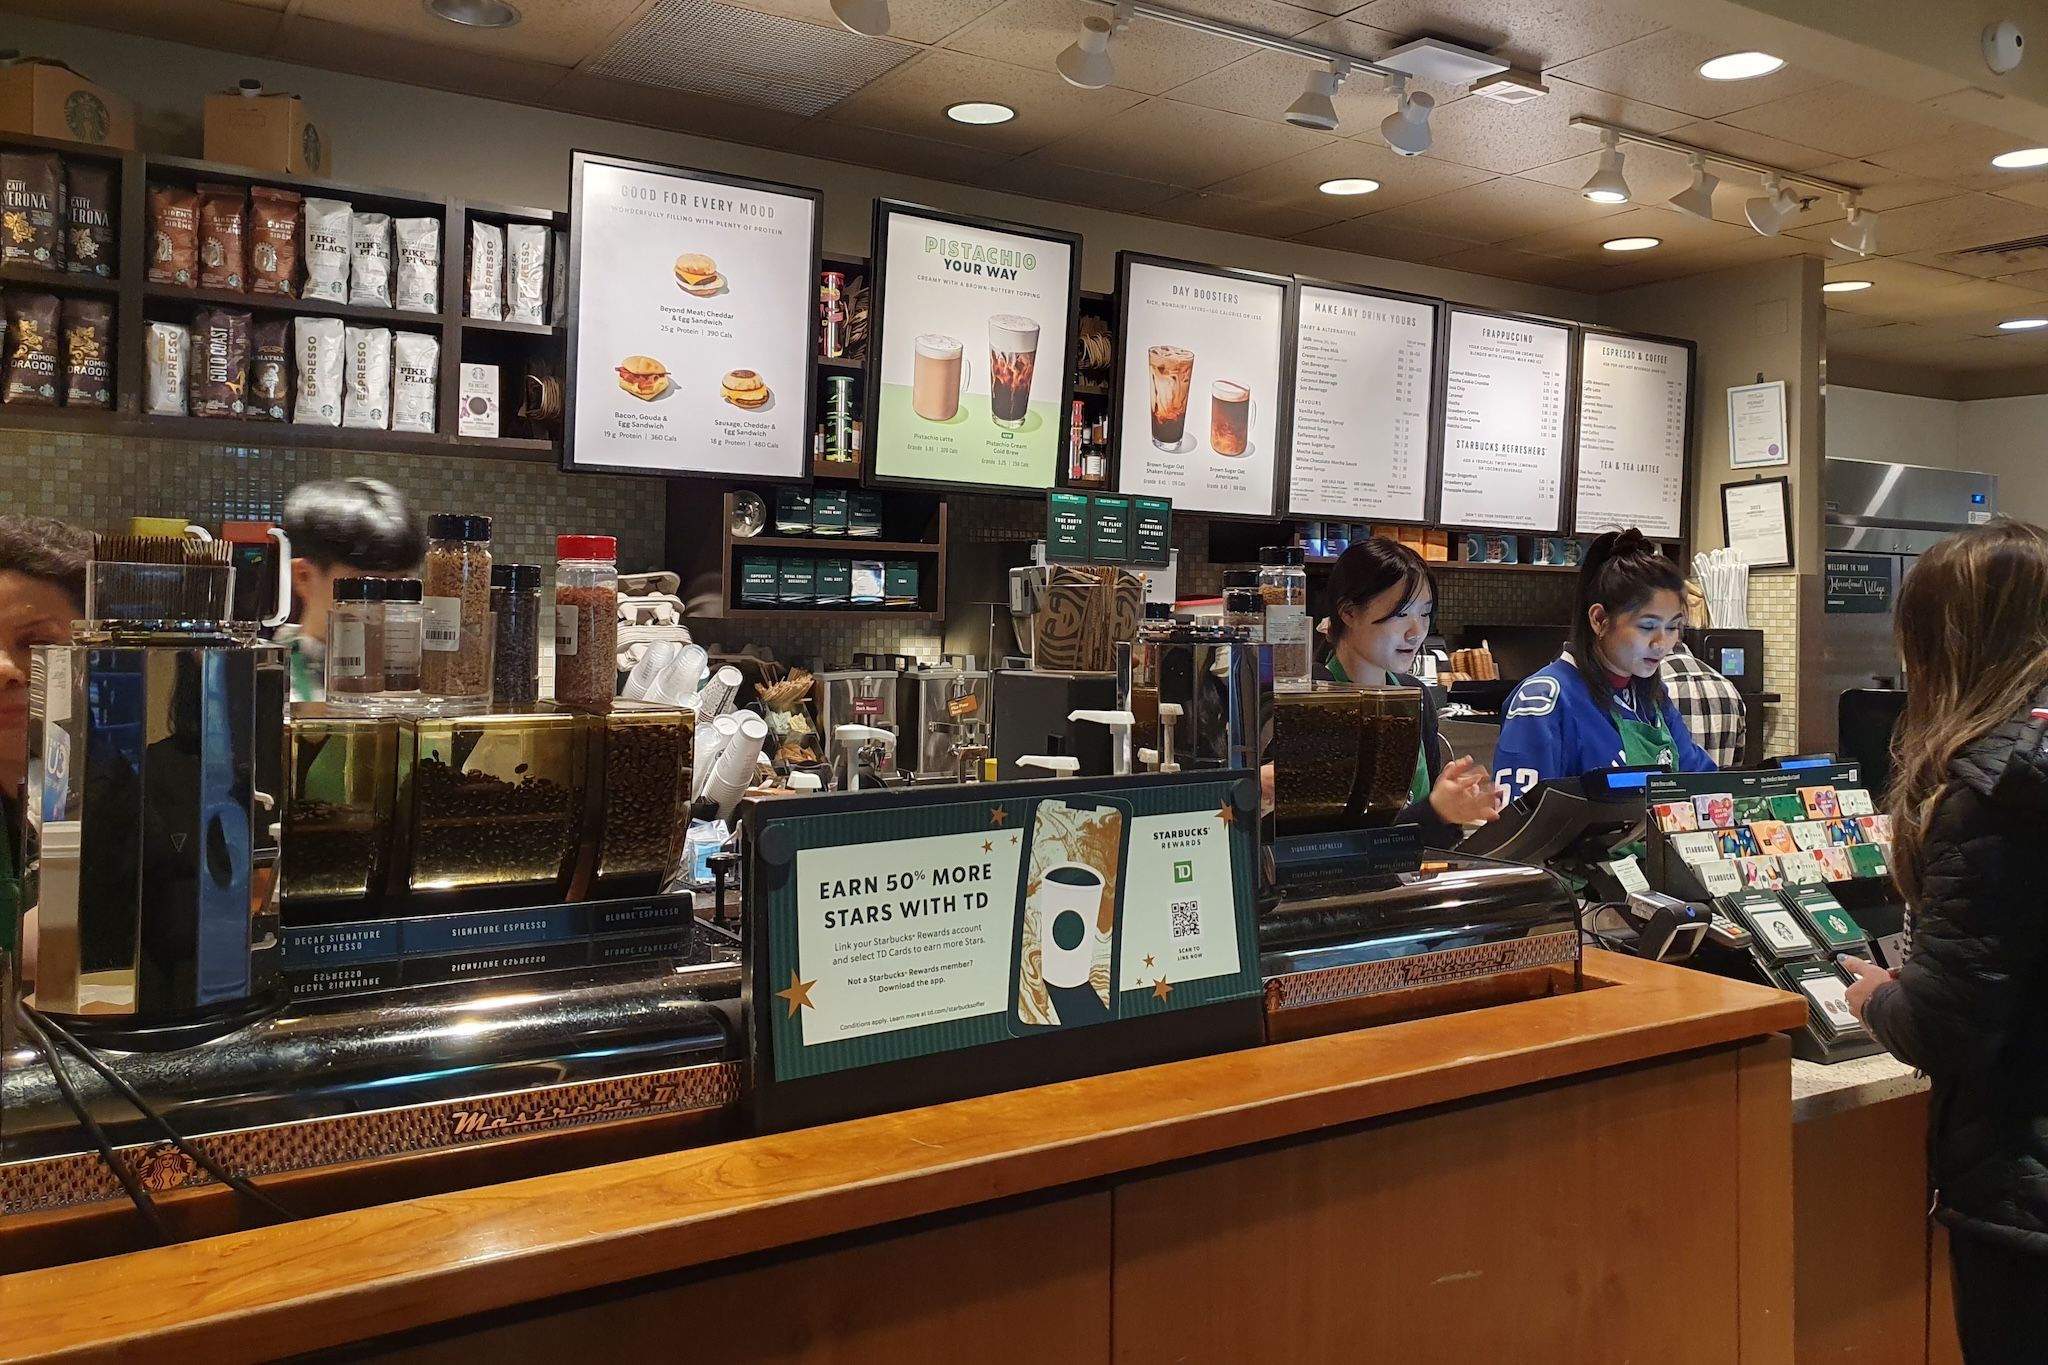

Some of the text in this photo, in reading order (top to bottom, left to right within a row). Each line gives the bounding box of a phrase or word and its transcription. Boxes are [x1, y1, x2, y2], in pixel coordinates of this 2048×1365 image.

[621, 185, 775, 219] GOOD FOR EVERY MOOD
[666, 213, 693, 223] FILLING
[696, 218, 714, 226] WITH
[716, 220, 741, 230] PLENTY
[754, 226, 783, 236] PROTEIN
[314, 243, 346, 254] PLACE
[401, 248, 426, 259] PIKE
[925, 236, 1037, 271] PISTACHIO
[485, 241, 494, 298] ESPRESSO
[944, 258, 1018, 281] YOUR WAY
[917, 275, 941, 284] CREAMY
[943, 278, 958, 286] WITH
[1016, 290, 1040, 299] TOPPING
[1172, 285, 1239, 304] DAY BOOSTERS
[659, 305, 734, 320] Beyond Cheddar
[1314, 303, 1416, 327] MAKE ANY DRINK YOURS
[678, 316, 690, 325] Egg
[691, 317, 723, 327] Sandwich
[677, 327, 699, 336] Protein
[1482, 328, 1533, 343] FRAPPUCCINO
[210, 327, 228, 356] COAST
[307, 336, 317, 397] ESPRESSO
[357, 342, 367, 400] ESPRESSO
[400, 367, 427, 376] PIKE
[614, 412, 637, 421] Bacon,
[639, 413, 661, 422] Gouda
[618, 420, 665, 430] Egg Sandwich
[714, 419, 742, 428] Sausage,
[743, 422, 770, 430] Cheddar
[619, 432, 643, 440] Protein
[724, 428, 767, 438] Egg Sandwich
[940, 435, 954, 443] Latte
[1456, 439, 1499, 452] STARBUCKS
[1161, 839, 1202, 849] REWARDS
[1685, 845, 1714, 854] STARBUCKS
[1175, 863, 1191, 879] TD
[1708, 873, 1736, 883] STARBUCKS
[819, 863, 992, 900] EARN 50% MORE
[639, 907, 679, 918] ESPRESSO
[824, 891, 989, 929] STARS WITH TD
[451, 920, 547, 937] SIGNATURE ESPRESSO
[295, 930, 381, 946] DECAF SIGNATURE
[834, 939, 852, 952] Link
[853, 941, 872, 950] your
[917, 928, 950, 939] Rewards
[951, 924, 982, 935] account
[314, 942, 362, 954] ESPRESSO
[832, 937, 986, 966] and select TD Cards to earn more Stars.
[847, 978, 862, 986] Not
[909, 966, 939, 976] Rewards
[940, 960, 974, 971] member?
[878, 977, 946, 993] Download the app.
[839, 1020, 871, 1031] Conditions
[871, 1017, 889, 1026] apply.
[889, 1014, 905, 1023] Learn
[453, 1087, 675, 1134] Mastrena II
